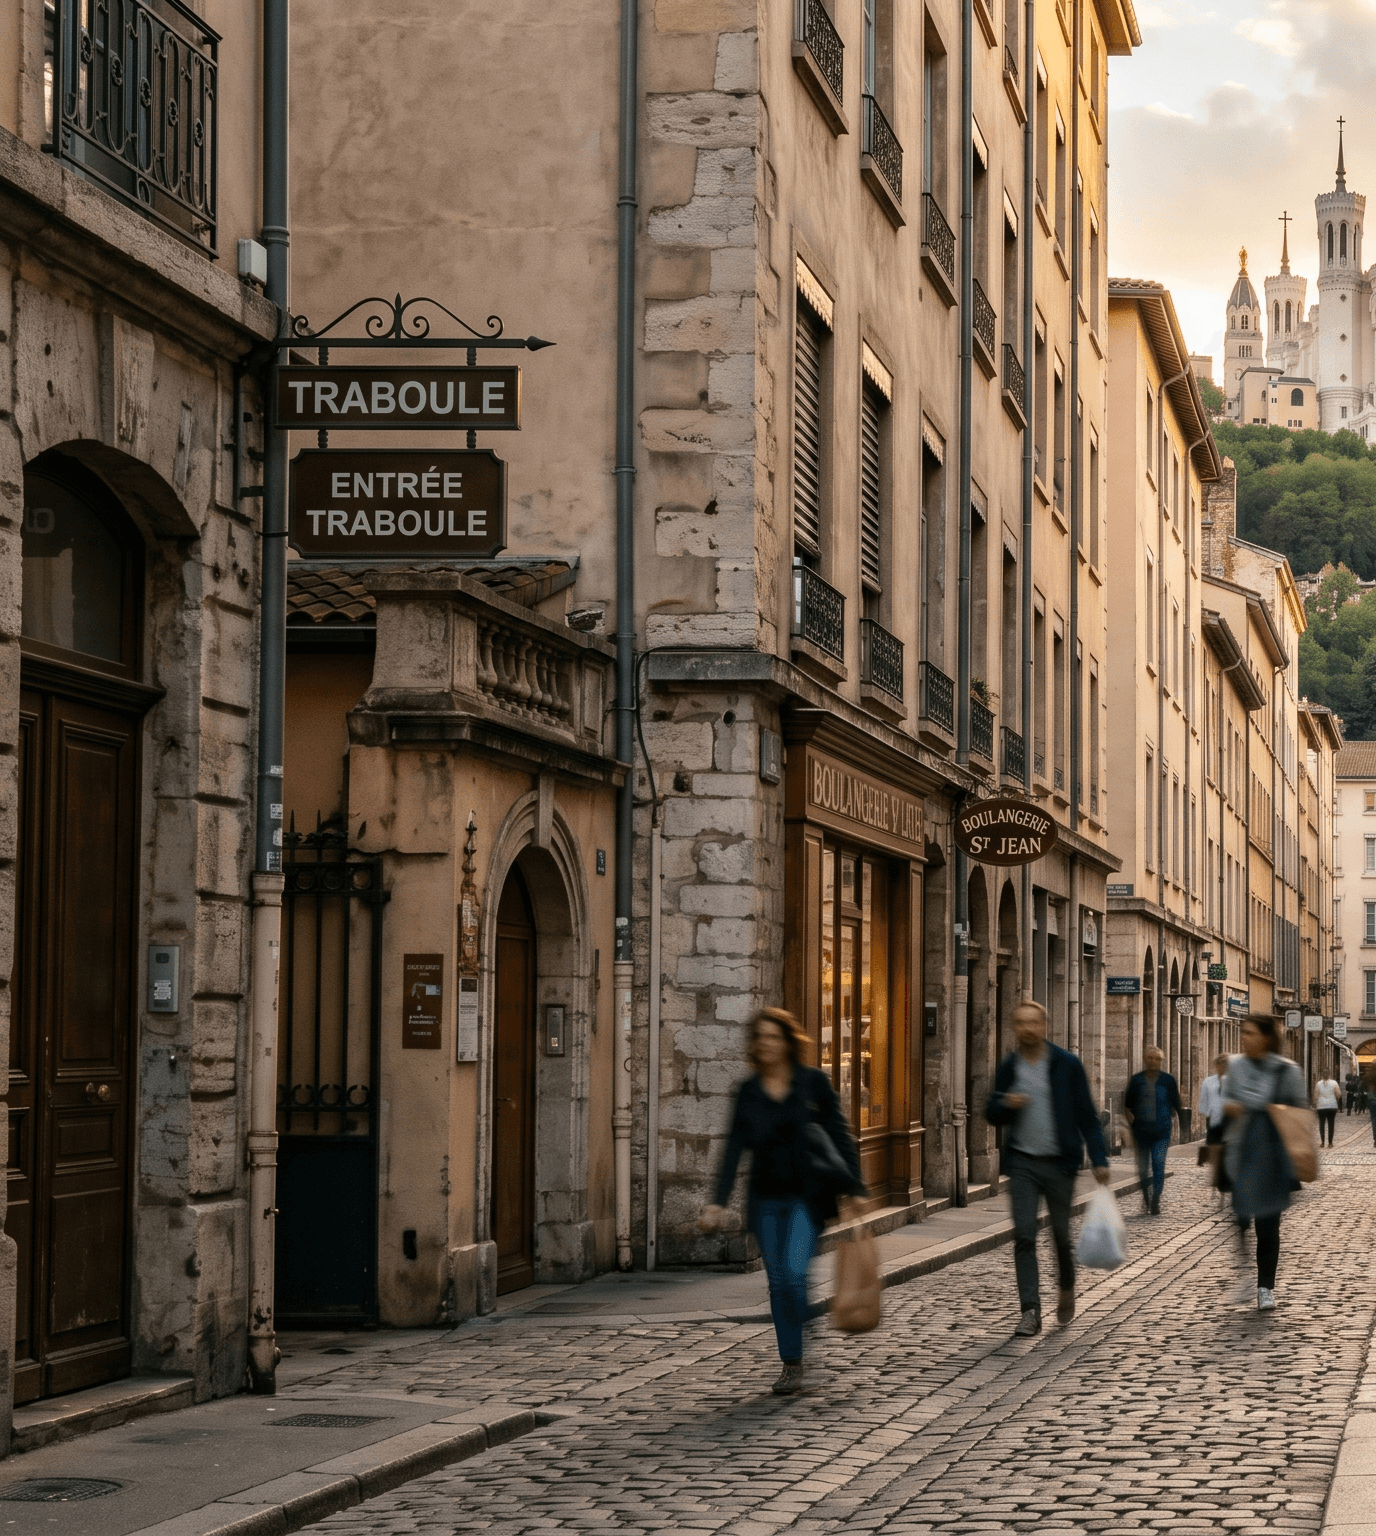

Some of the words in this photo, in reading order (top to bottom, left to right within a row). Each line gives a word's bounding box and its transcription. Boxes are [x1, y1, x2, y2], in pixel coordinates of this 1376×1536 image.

[288, 380, 505, 415] TRABOULE
[331, 465, 463, 499] ENTRÉE
[306, 509, 487, 537] TRABOULE
[961, 808, 1051, 836] BOULANGERIE
[996, 837, 1042, 855] JEAN
